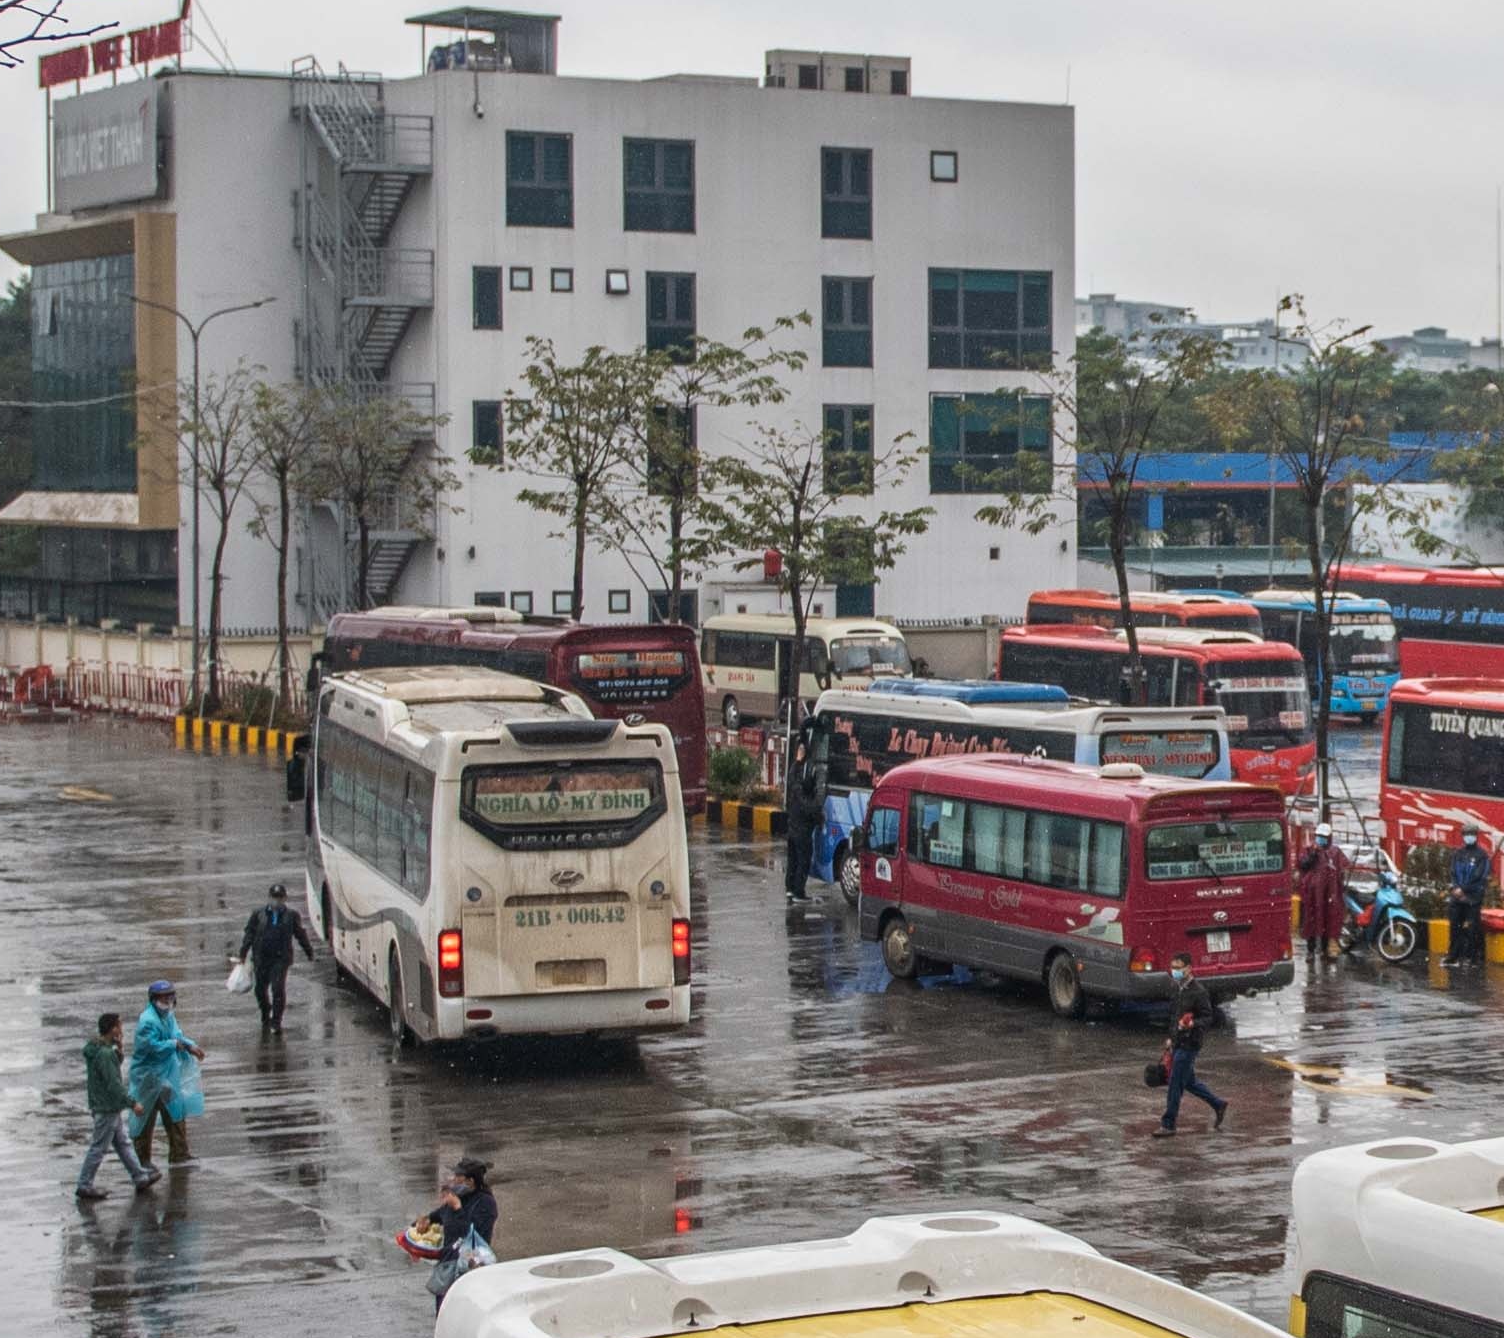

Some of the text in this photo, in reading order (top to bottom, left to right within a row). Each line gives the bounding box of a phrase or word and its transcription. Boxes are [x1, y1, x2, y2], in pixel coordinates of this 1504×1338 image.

[570, 793, 598, 811] MỸ
[601, 790, 646, 811] ĐÌNH
[510, 829, 626, 845] UNIVERSE
[988, 885, 1023, 910] Gold
[515, 907, 627, 928] 21B 006.42
